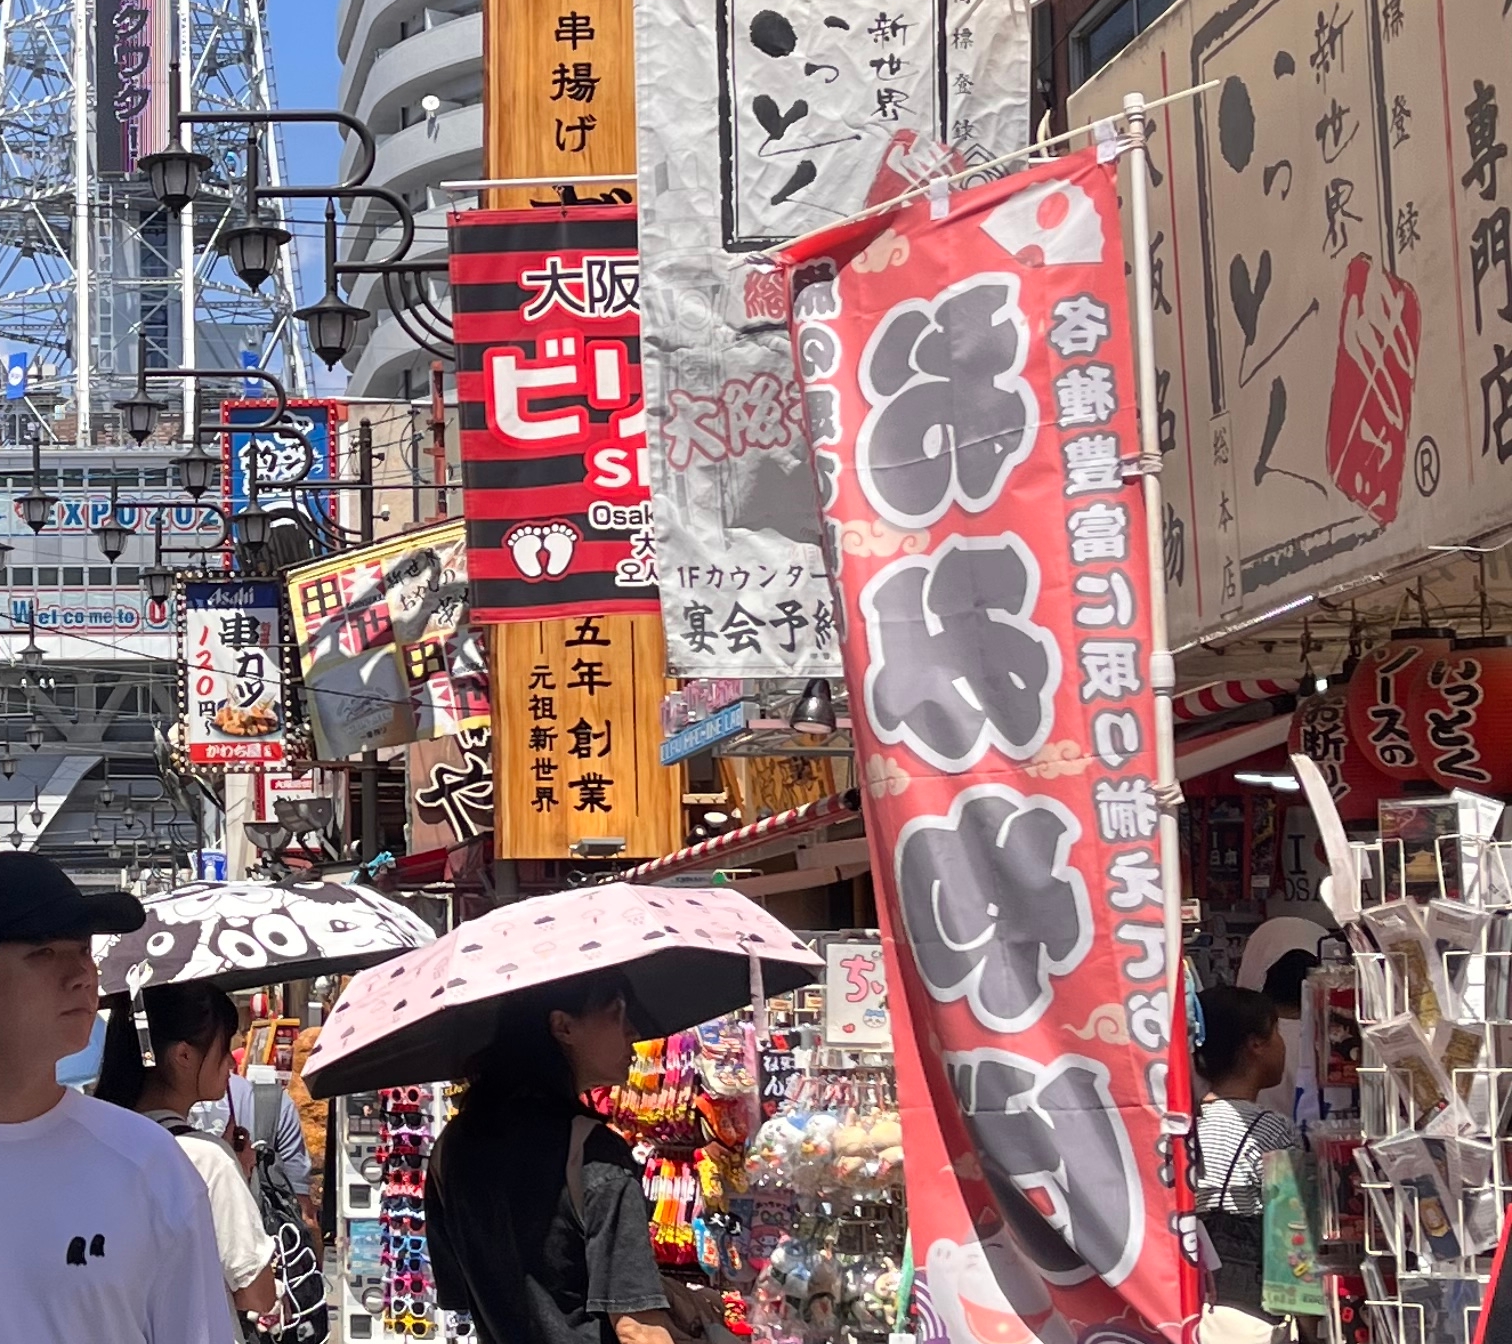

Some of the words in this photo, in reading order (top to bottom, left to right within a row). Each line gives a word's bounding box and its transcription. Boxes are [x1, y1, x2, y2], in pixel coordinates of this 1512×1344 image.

[550, 10, 603, 154] 串揚げ
[868, 11, 920, 123] 新世界
[1309, 0, 1363, 259] 新世界
[12, 599, 113, 626] Welcome
[117, 608, 136, 625] to
[208, 585, 255, 606] Asahi
[218, 612, 266, 709] 串カツ
[1367, 644, 1425, 769] ソースの
[1427, 655, 1492, 784] いっとく
[526, 662, 561, 815] 元祖新世界
